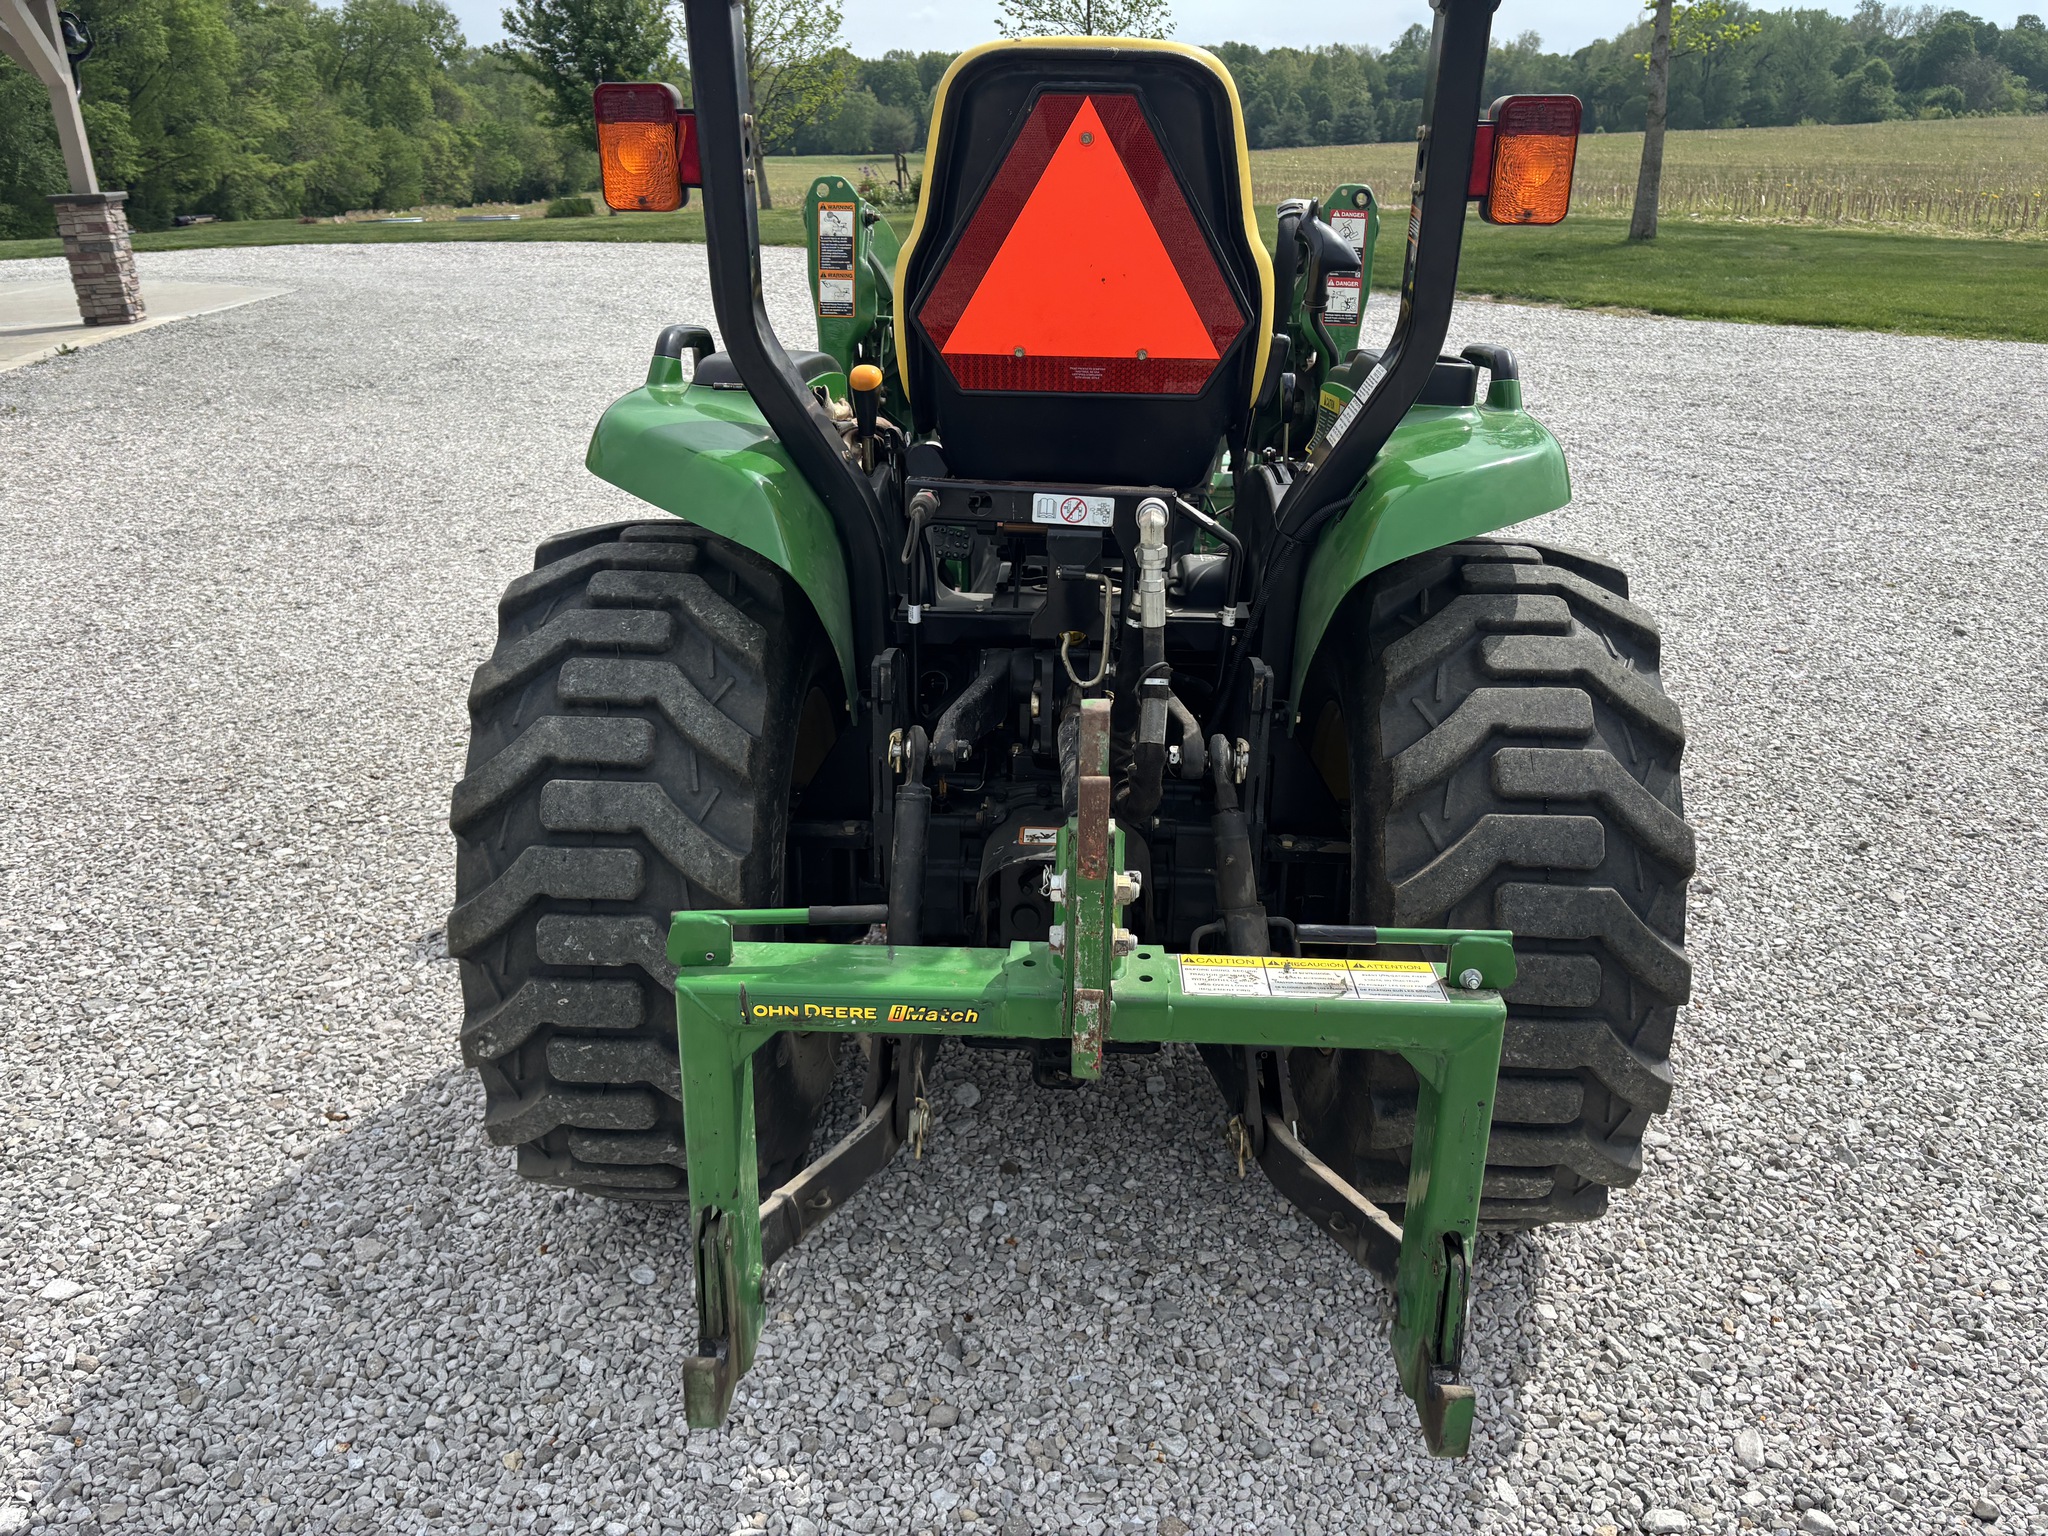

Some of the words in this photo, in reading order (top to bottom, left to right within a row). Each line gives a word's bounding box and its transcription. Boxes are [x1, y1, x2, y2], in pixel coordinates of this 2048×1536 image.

[1195, 956, 1255, 966] CAUTION
[741, 1004, 799, 1017] OHN
[804, 1003, 877, 1019] DEERE
[889, 1005, 979, 1023] iMatch
